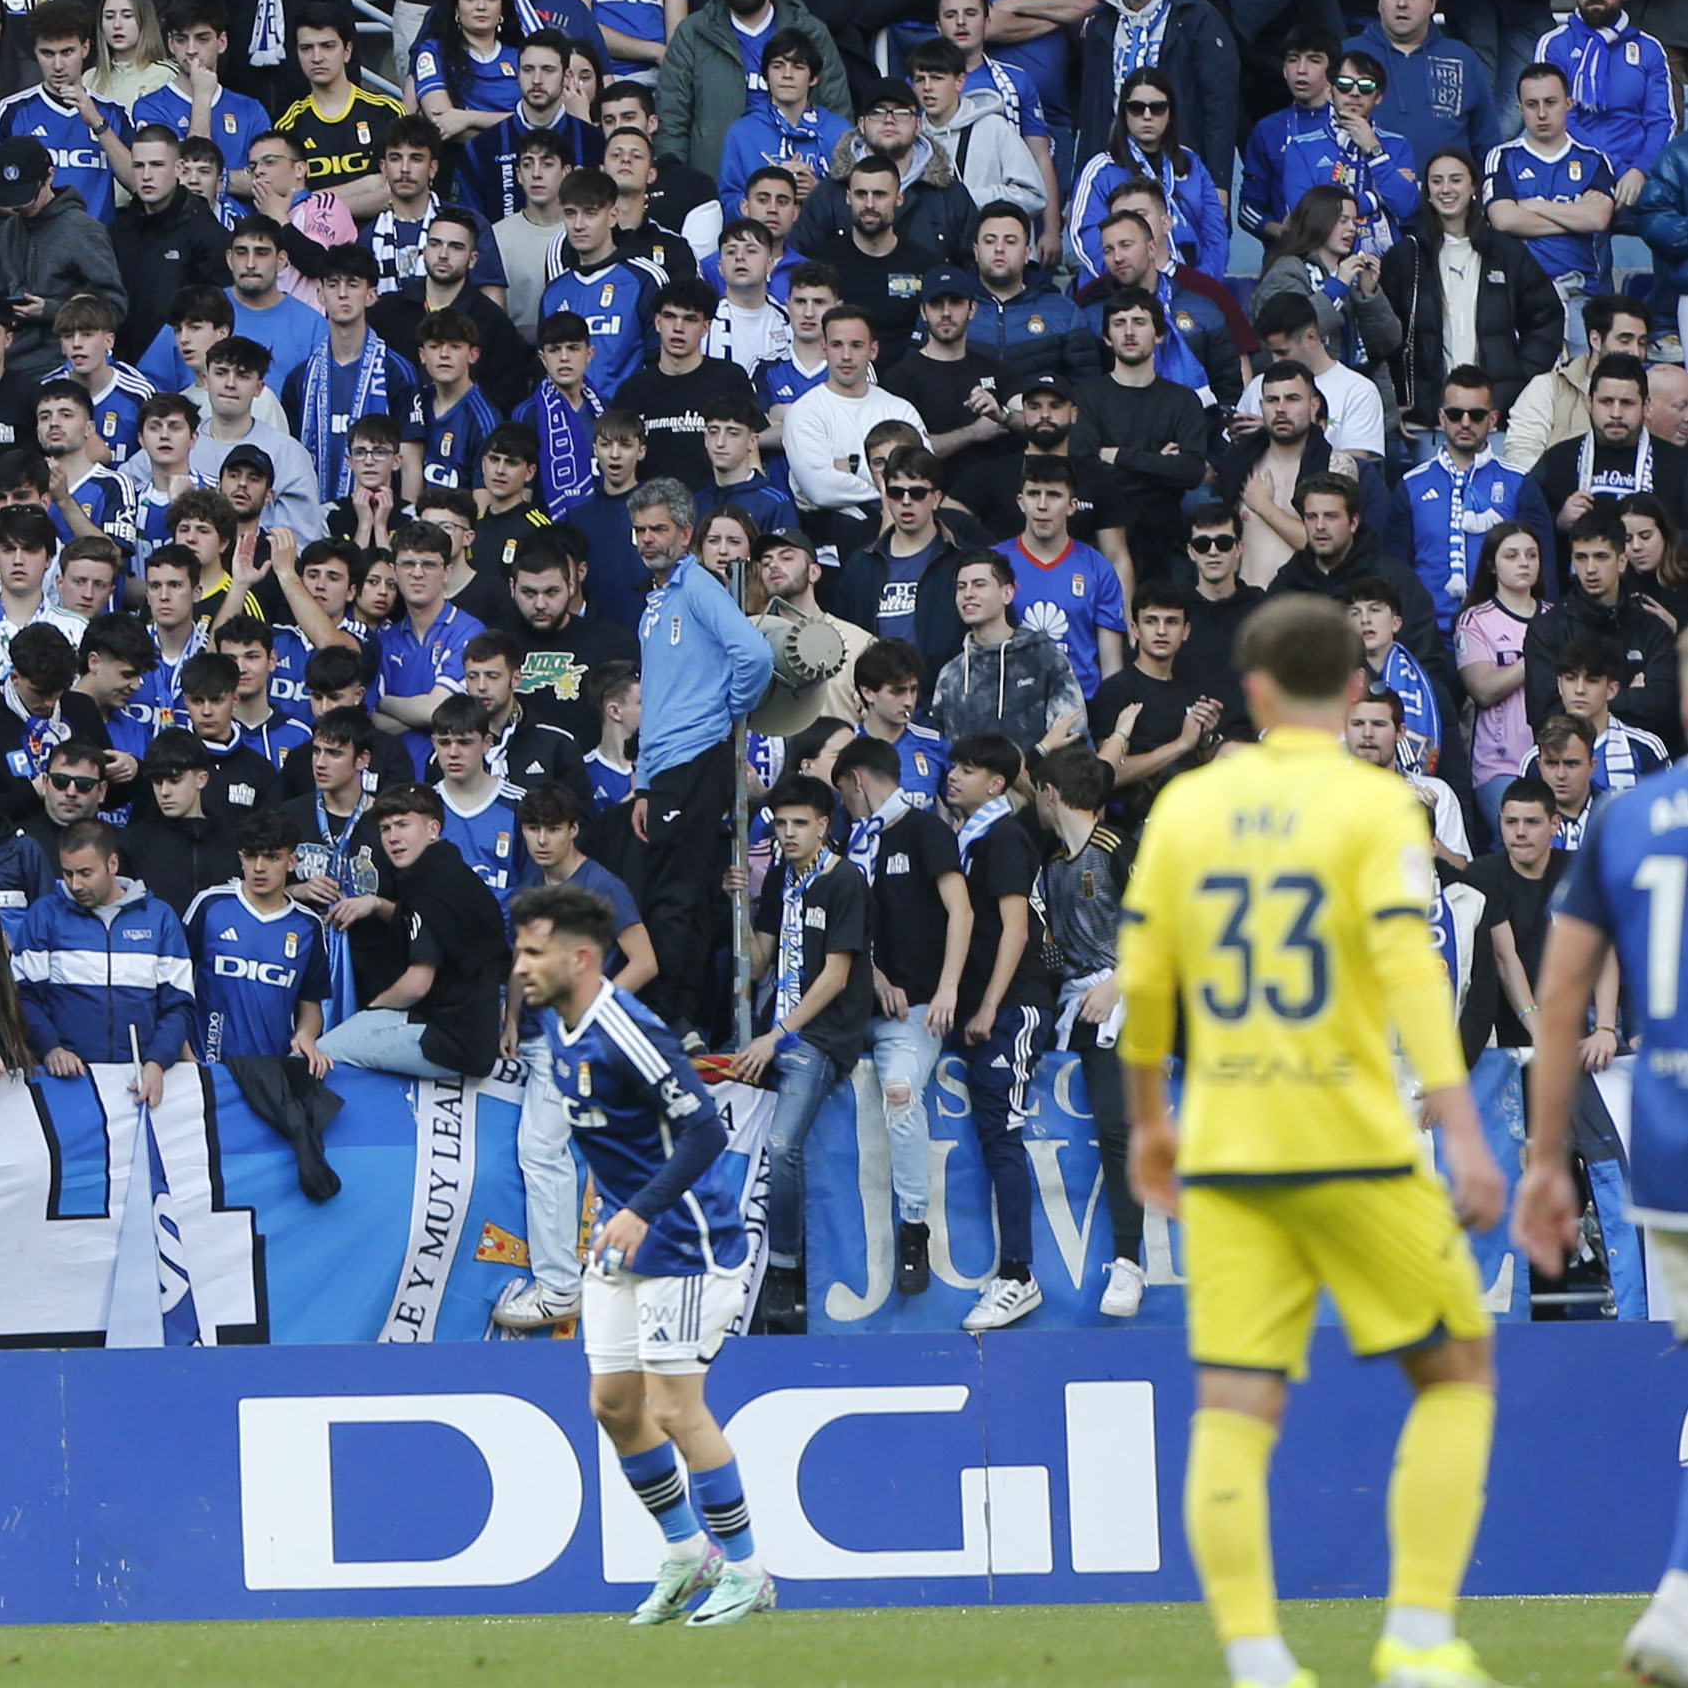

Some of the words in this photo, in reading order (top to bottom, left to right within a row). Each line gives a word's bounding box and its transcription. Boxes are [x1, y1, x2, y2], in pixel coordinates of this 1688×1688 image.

[213, 954, 297, 990] DIGI
[1200, 874, 1330, 1024] 33
[433, 1075, 464, 1164] LEAL
[423, 1172, 459, 1262] MUY
[407, 1269, 435, 1291] Y
[238, 1380, 1161, 1592] DIGI
